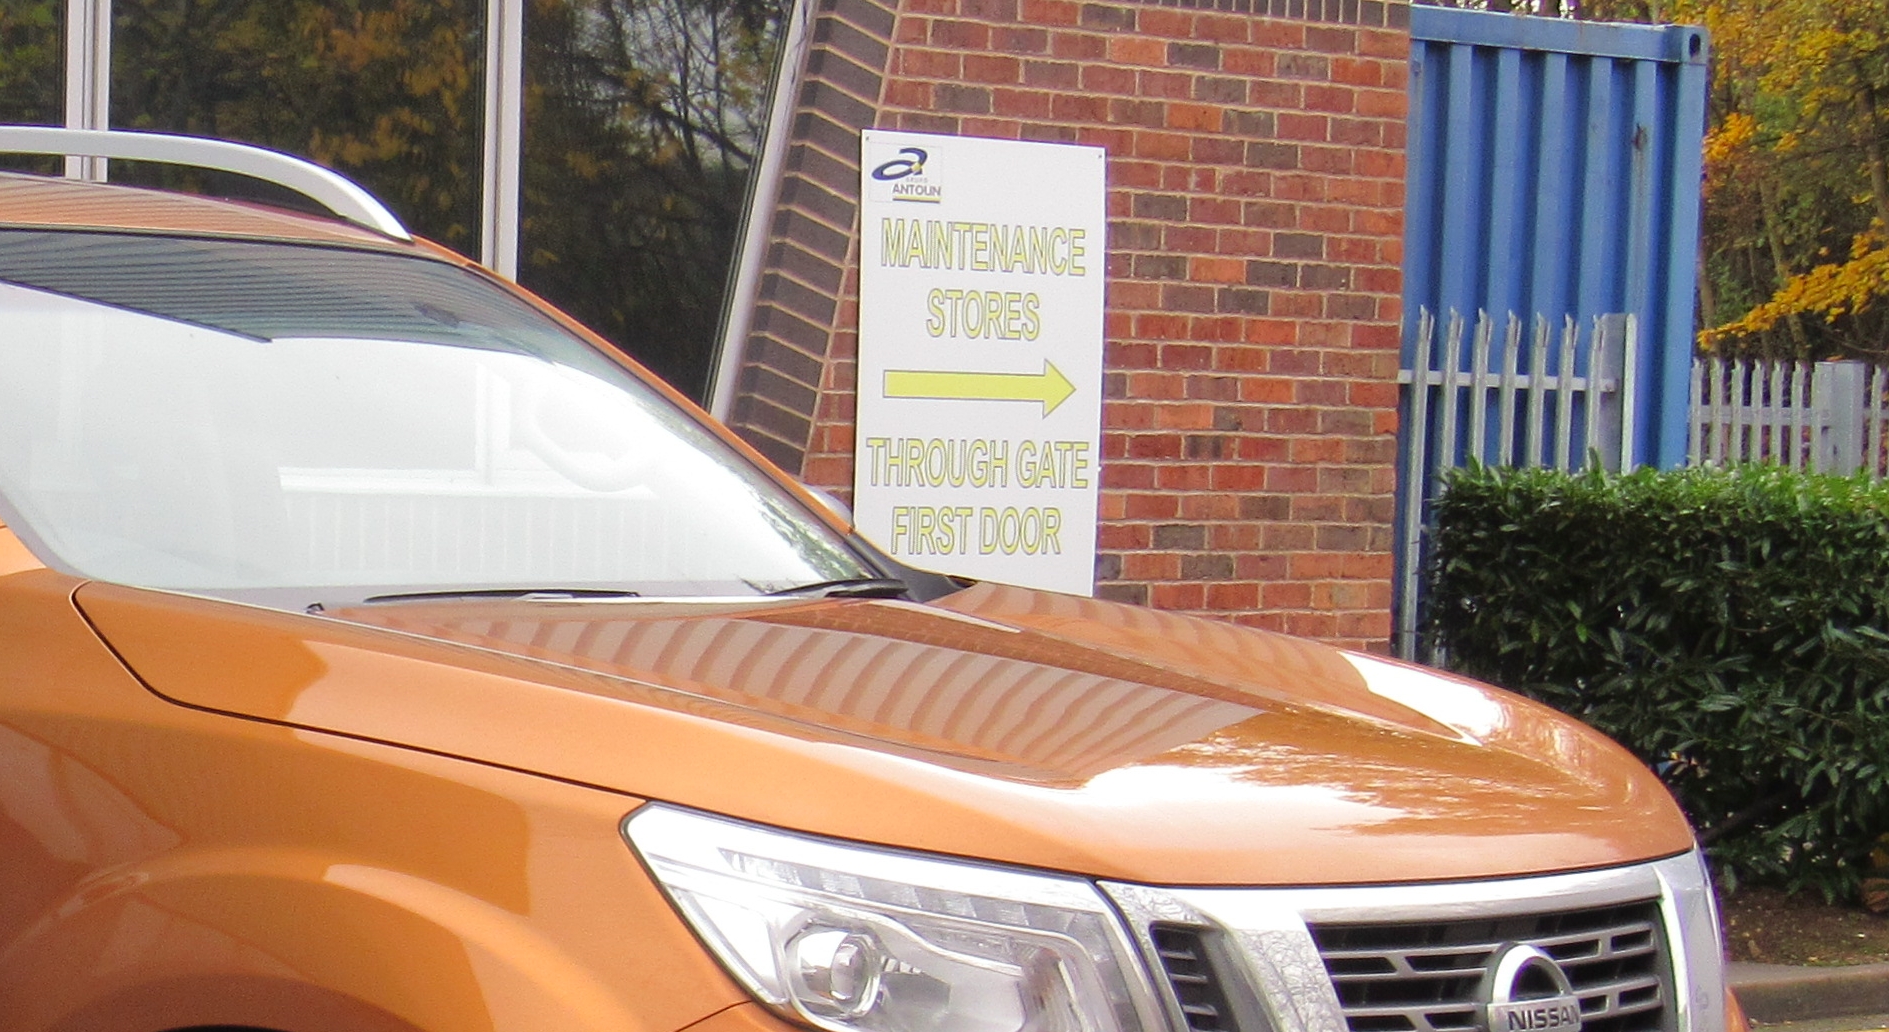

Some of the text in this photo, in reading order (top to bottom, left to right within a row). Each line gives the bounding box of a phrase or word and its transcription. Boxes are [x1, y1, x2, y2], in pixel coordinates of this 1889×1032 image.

[880, 217, 1086, 276] MAINTENANCE
[926, 288, 1041, 341] STORES
[866, 437, 1090, 489] THROUGH GATE
[890, 507, 1062, 555] FIRST DOOR
[1507, 1004, 1580, 1031] NISSAN
